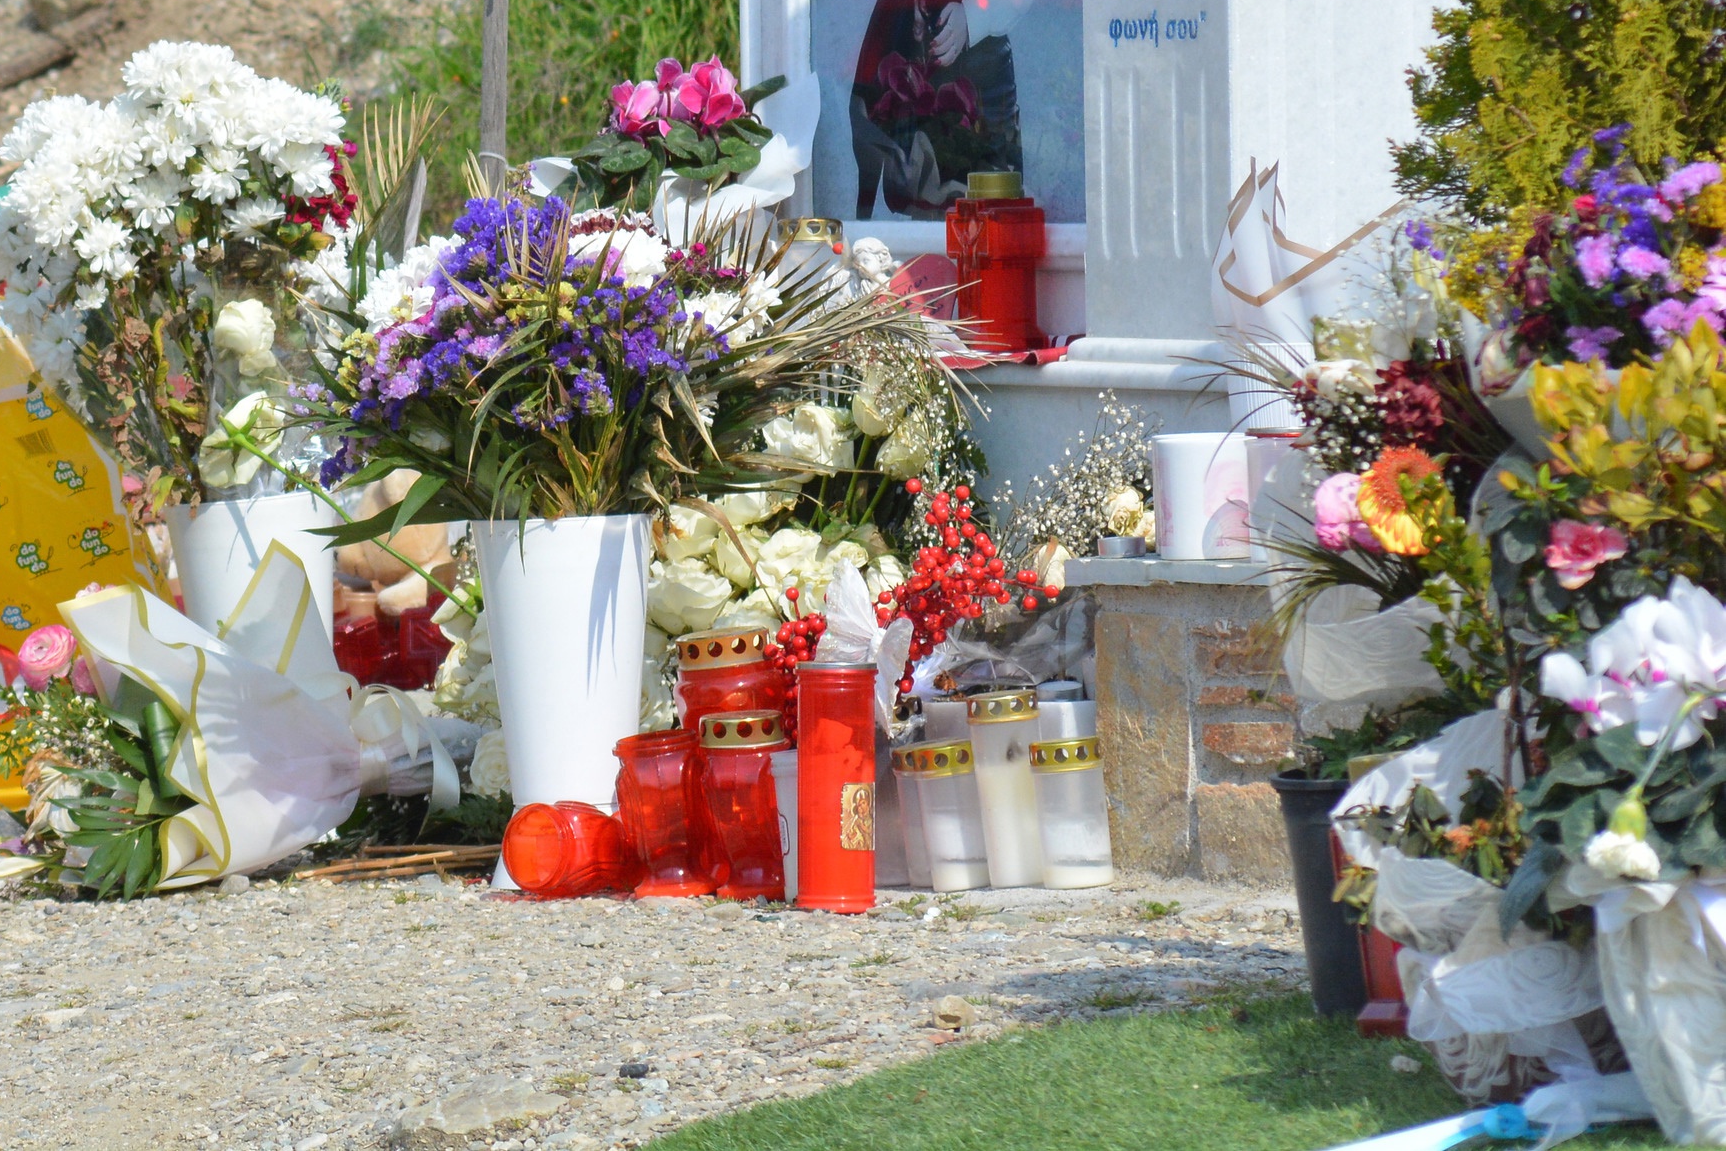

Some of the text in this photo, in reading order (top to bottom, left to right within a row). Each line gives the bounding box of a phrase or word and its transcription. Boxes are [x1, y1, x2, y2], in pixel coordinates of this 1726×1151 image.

[1109, 9, 1159, 48] φωνή
[28, 401, 44, 413] fun
[38, 407, 52, 418] do
[55, 470, 75, 482] fun
[69, 477, 83, 487] do
[84, 529, 99, 540] do
[20, 544, 36, 556] do
[81, 538, 101, 551] fun
[94, 545, 108, 556] do
[17, 554, 38, 567] fun
[31, 561, 47, 573] do
[5, 607, 19, 616] do
[2, 614, 21, 624] fun
[15, 621, 30, 630] do
